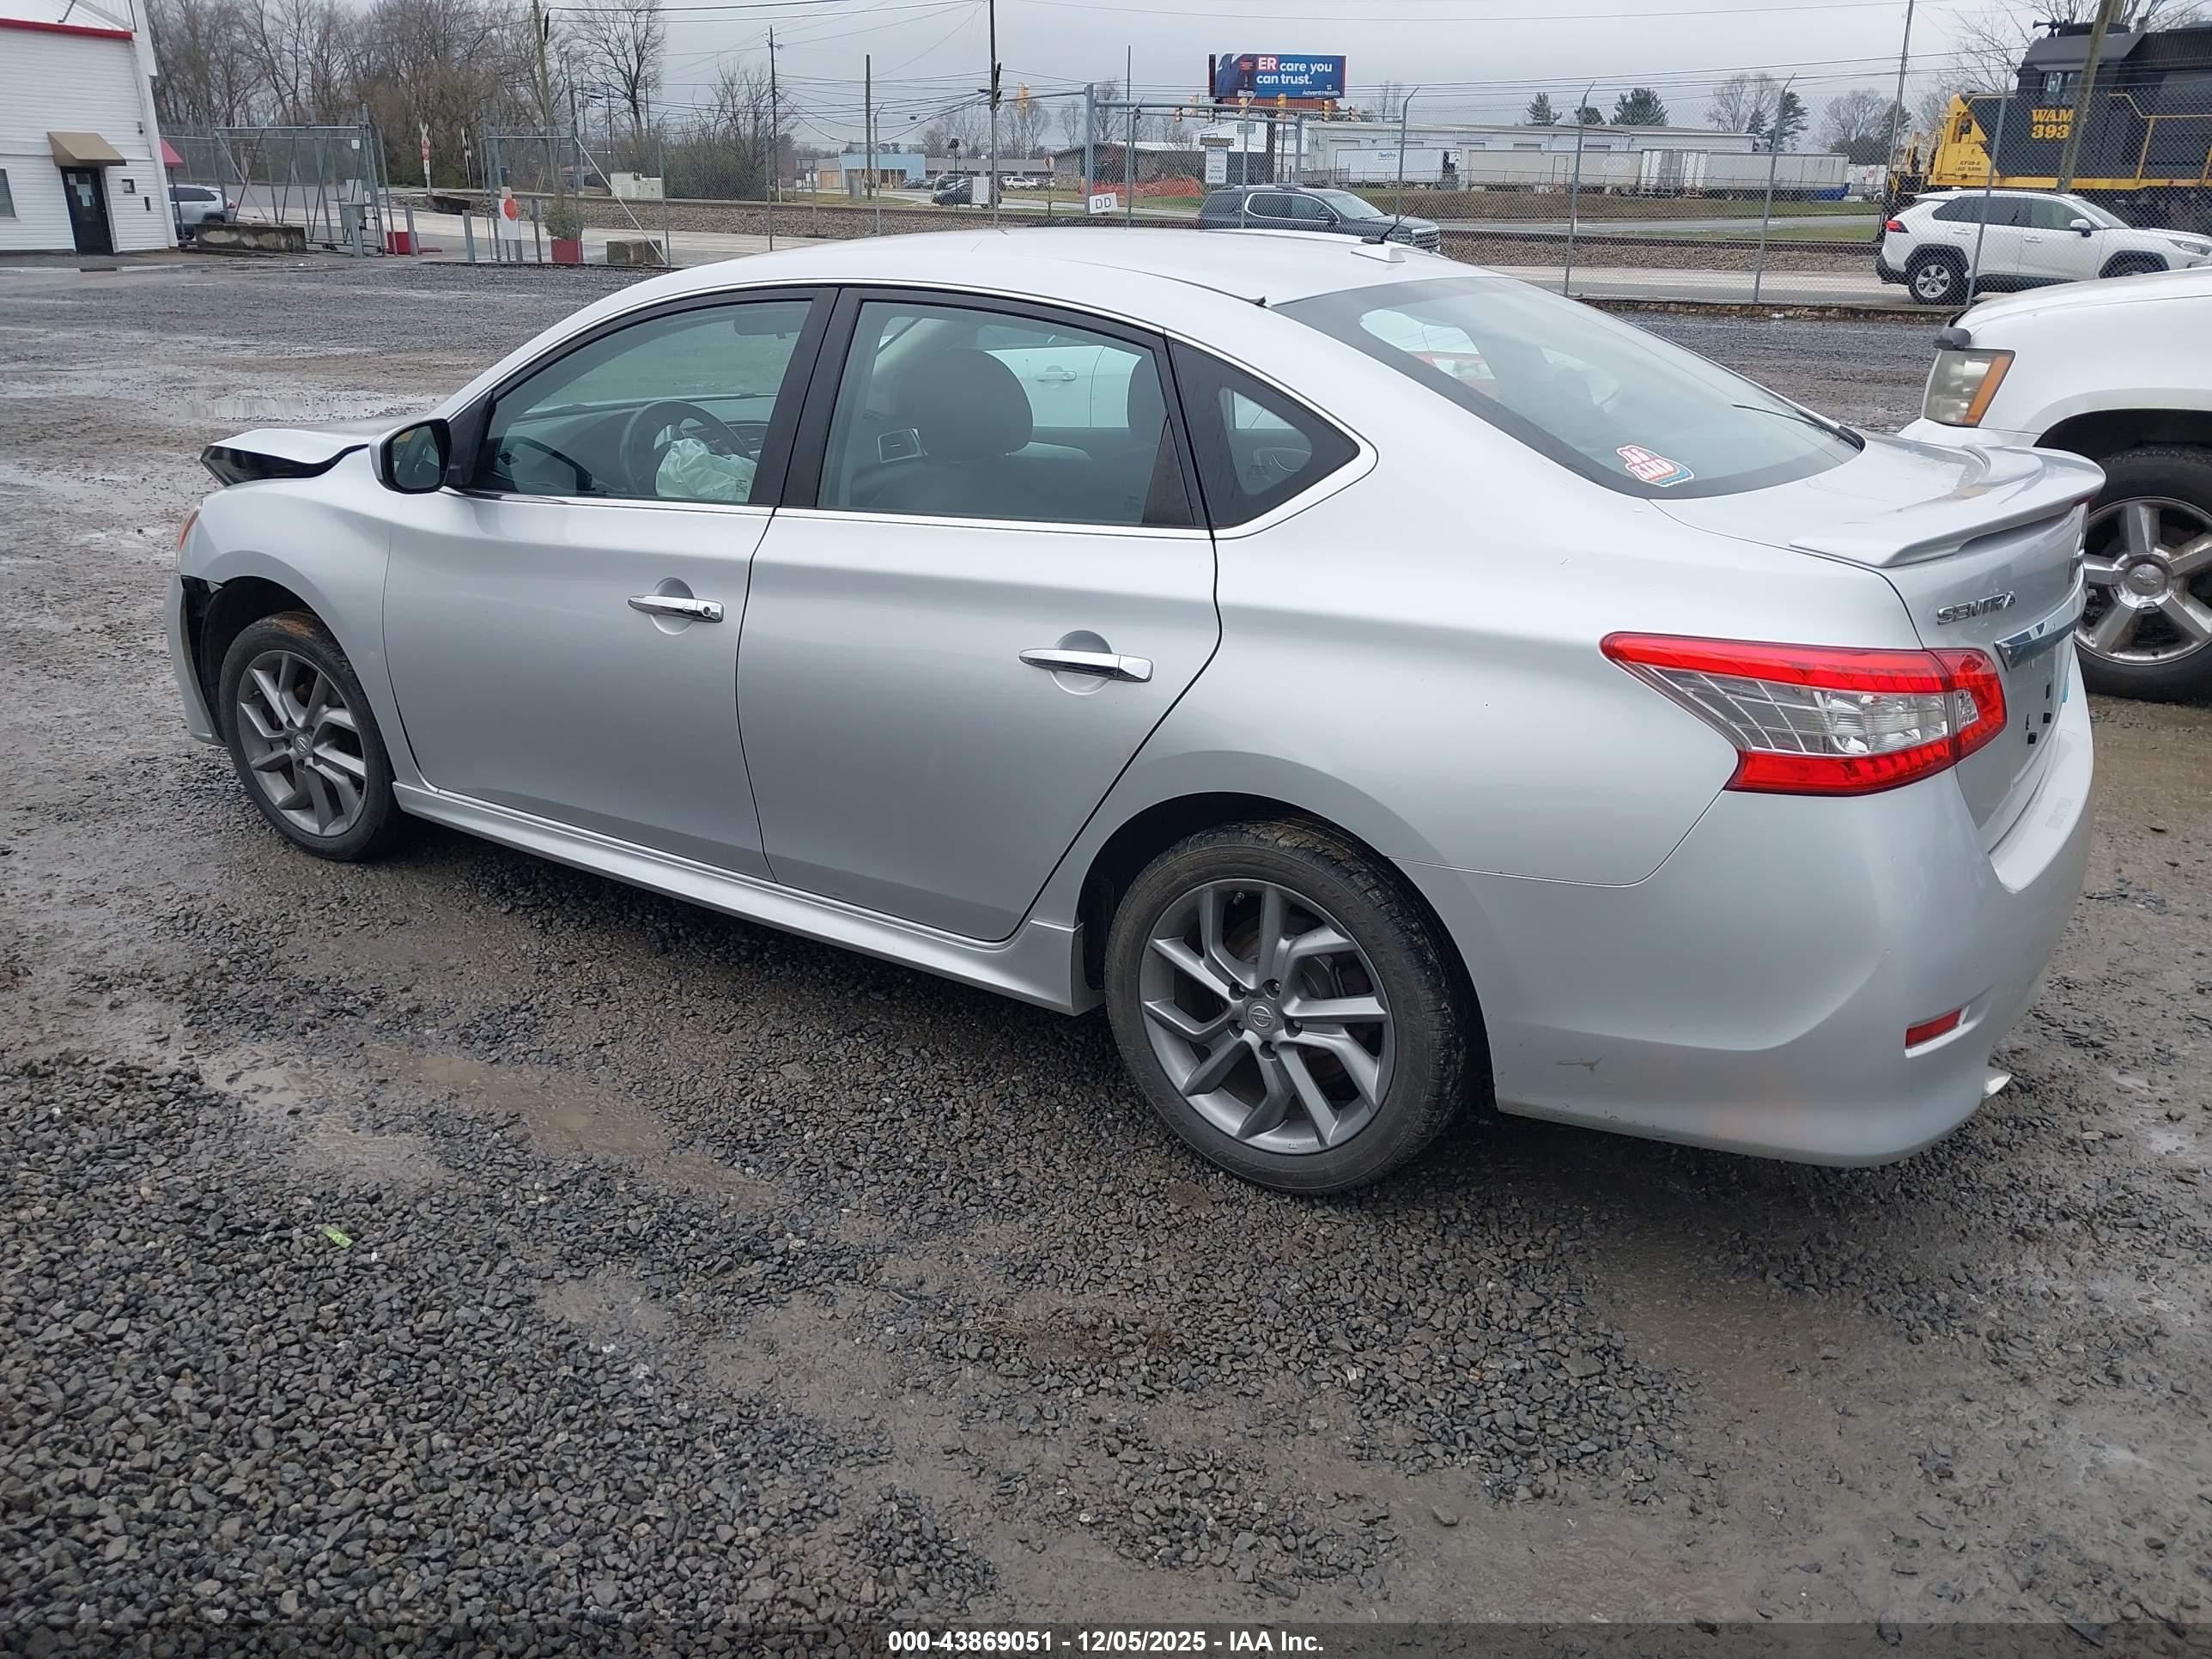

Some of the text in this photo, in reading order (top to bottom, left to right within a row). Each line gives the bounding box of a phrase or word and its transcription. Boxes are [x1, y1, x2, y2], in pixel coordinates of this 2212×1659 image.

[1258, 57, 1277, 70] ER
[1279, 62, 1307, 72] care
[1310, 63, 1333, 75] you
[1256, 74, 1313, 84] can trust.
[2032, 109, 2089, 122] WAM
[1095, 197, 1112, 210] DD
[1630, 459, 1675, 480] KIND
[1936, 591, 2016, 626] SENTRA
